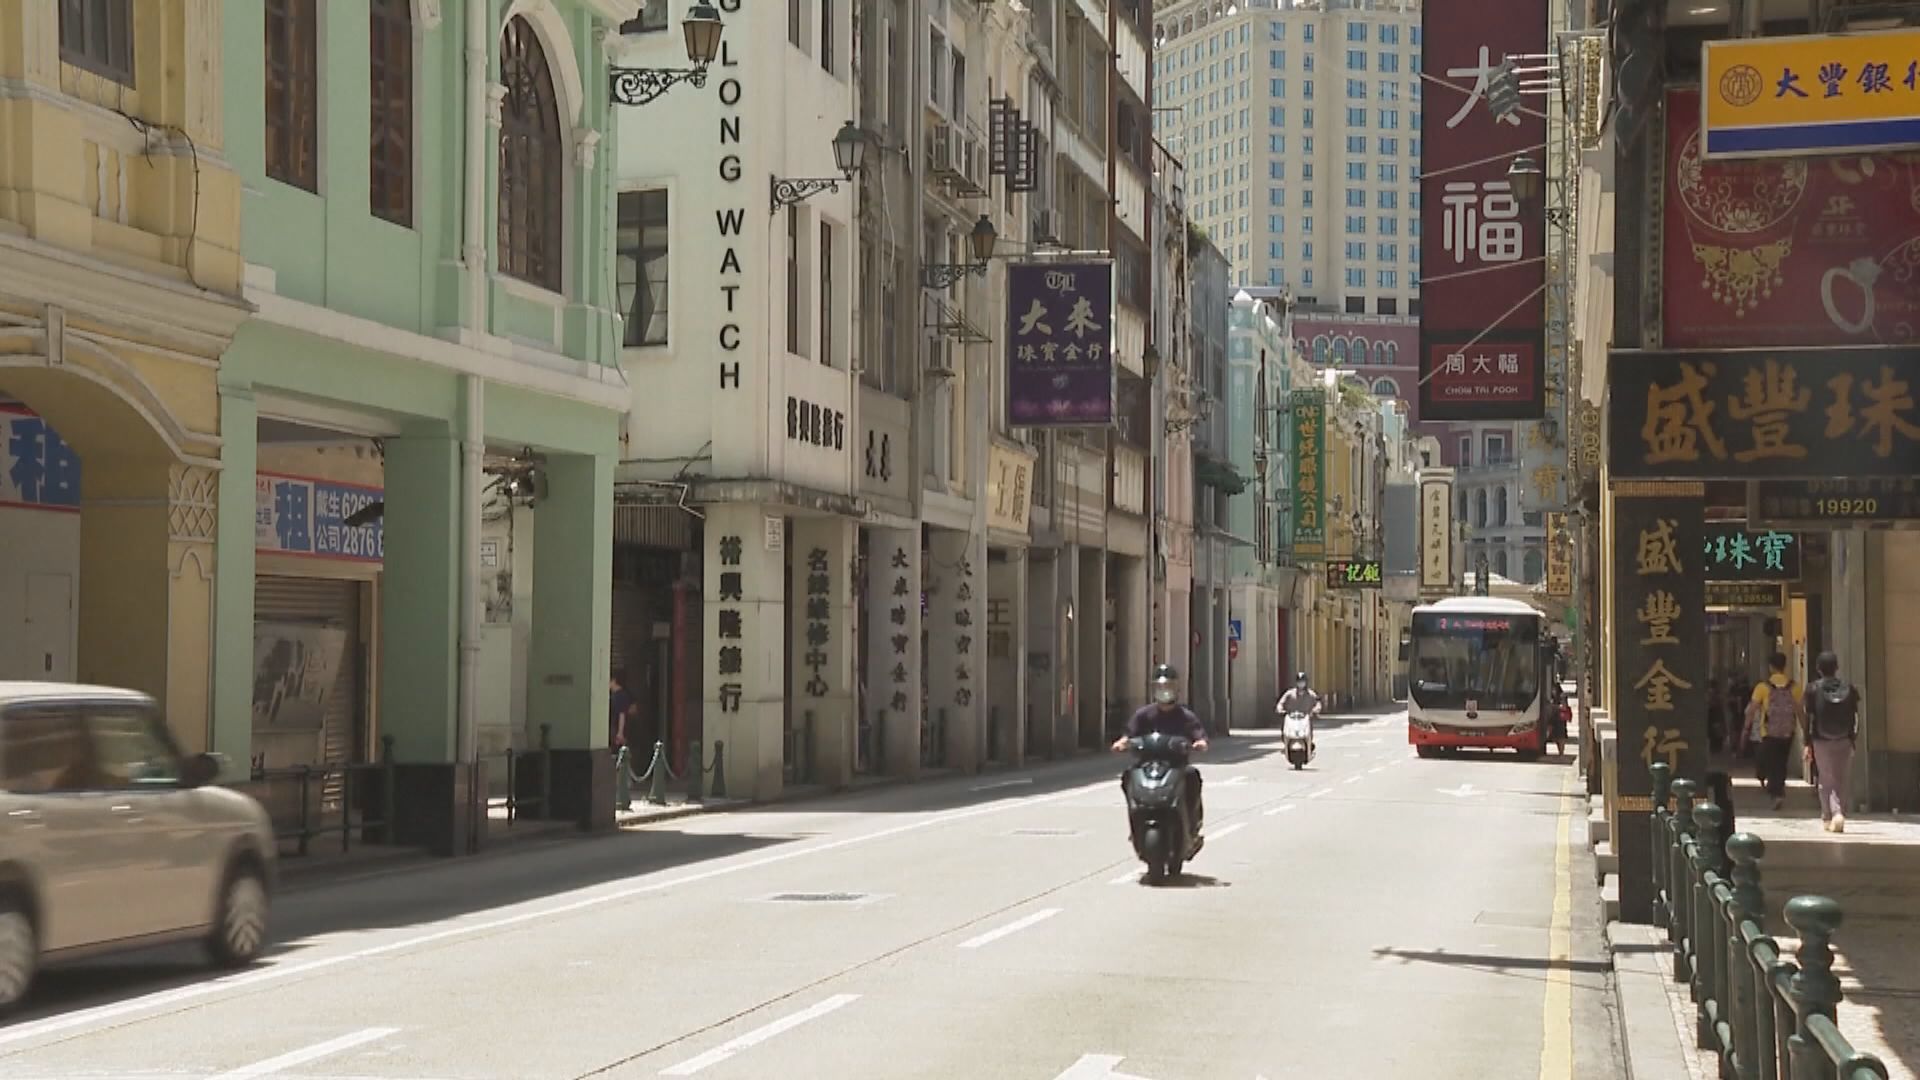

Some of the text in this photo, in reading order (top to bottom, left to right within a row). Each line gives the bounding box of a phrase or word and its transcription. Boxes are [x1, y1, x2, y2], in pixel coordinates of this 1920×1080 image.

[719, 40, 741, 183] LONG
[716, 208, 745, 389] WATCH
[1017, 342, 1103, 362] 珠寶金行
[1446, 354, 1519, 375] 周大福
[1445, 386, 1472, 395] CHOW
[1474, 386, 1490, 395] TAI
[1641, 359, 1920, 465] 盛豐珠
[275, 481, 311, 551] 租
[1816, 499, 1877, 515] 19920
[316, 524, 340, 551] 公司
[342, 526, 375, 557] 2876
[1704, 530, 1794, 570] 珠寶
[1633, 518, 1693, 775] 盛豐金行
